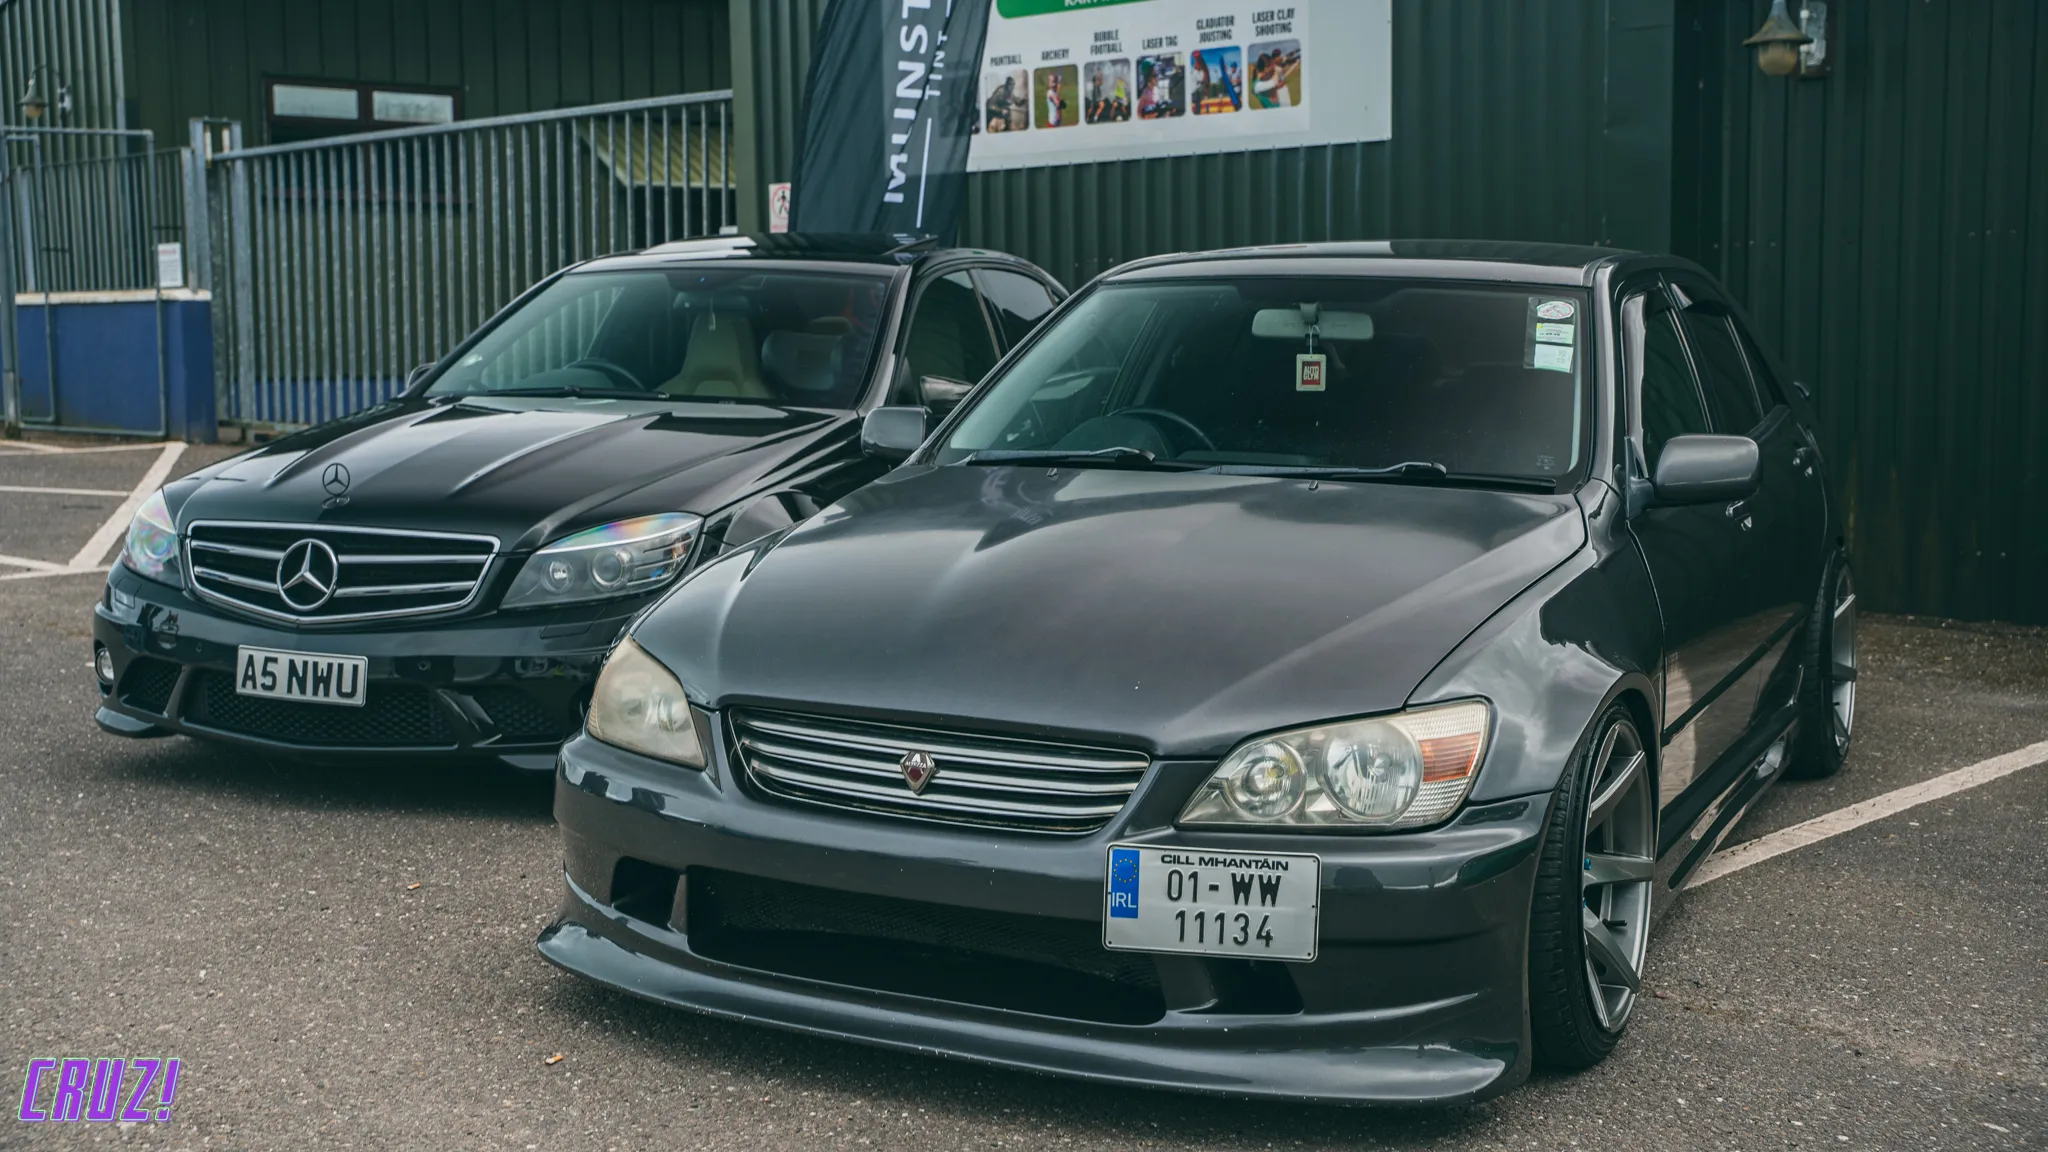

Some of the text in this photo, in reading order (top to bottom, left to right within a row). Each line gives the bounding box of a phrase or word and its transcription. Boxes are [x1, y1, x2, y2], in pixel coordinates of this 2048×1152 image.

[1196, 15, 1235, 31] GLADIATOR
[1252, 8, 1295, 24] LASER CLAY
[1093, 29, 1119, 43] BUBBLE
[1199, 29, 1232, 43] JOUSTING
[1255, 22, 1292, 37] SHOOTING
[1090, 42, 1122, 56] FOOTBALL
[1142, 35, 1178, 50] LASER TAG
[990, 54, 1022, 67] PAINTBALL
[1041, 48, 1070, 61] ARCHERY
[924, 30, 948, 100] TINT
[241, 654, 359, 699] A5 NWU
[1161, 854, 1289, 871] CILL MHANTÁIN
[1111, 892, 1137, 909] IRL
[1175, 909, 1274, 947] 11134
